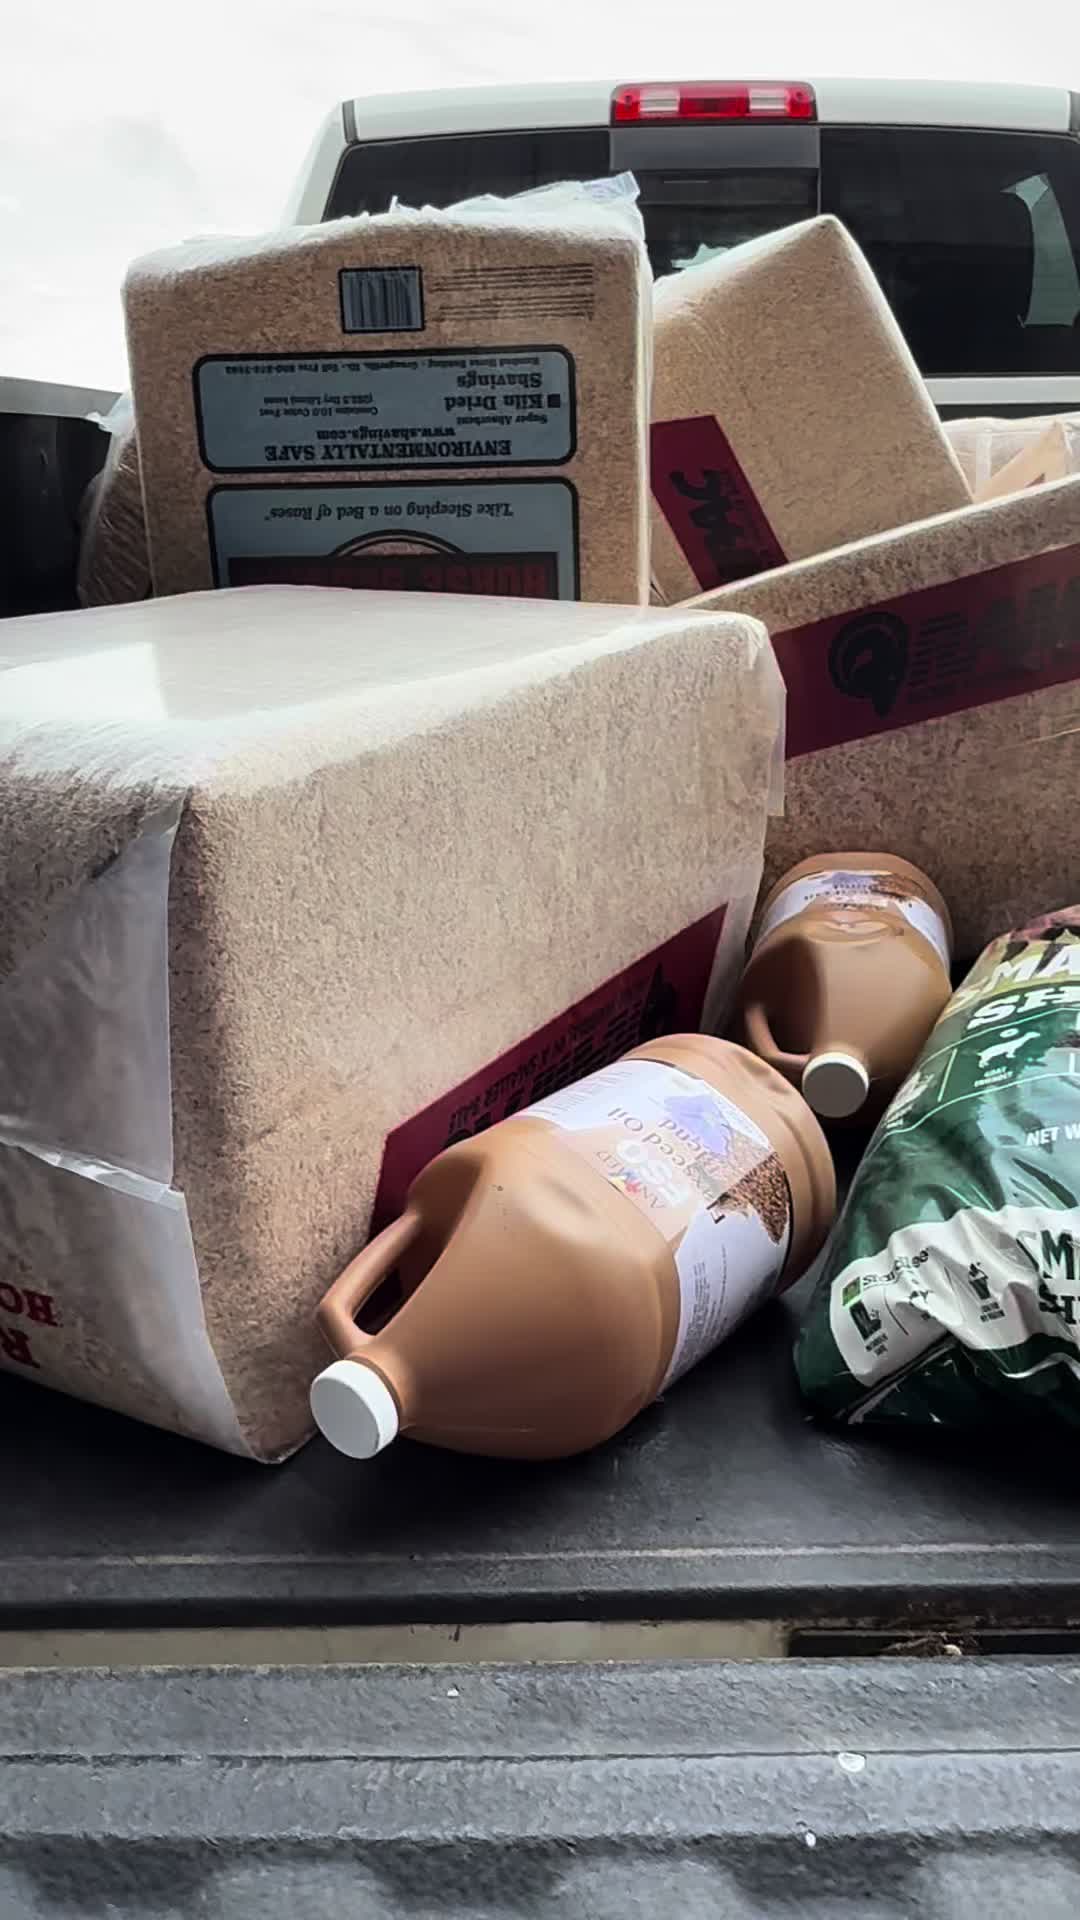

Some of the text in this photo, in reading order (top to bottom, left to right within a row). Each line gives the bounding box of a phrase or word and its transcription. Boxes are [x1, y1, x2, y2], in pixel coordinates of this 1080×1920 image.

[456, 371, 543, 390] Shavings
[444, 394, 543, 411] Kiln Dried
[456, 413, 548, 426] Super Absorbent
[316, 426, 456, 442] www.shavings.com
[264, 440, 512, 462] ENVIRONMENTALLY SAFE
[315, 503, 332, 521] of
[336, 506, 365, 521] Bed
[369, 505, 380, 516] a
[383, 504, 402, 516] on
[406, 501, 473, 519] Sleeping
[606, 1106, 645, 1132] Oil
[1025, 1126, 1060, 1147] NET
[640, 1132, 728, 1226] Flaxseed
